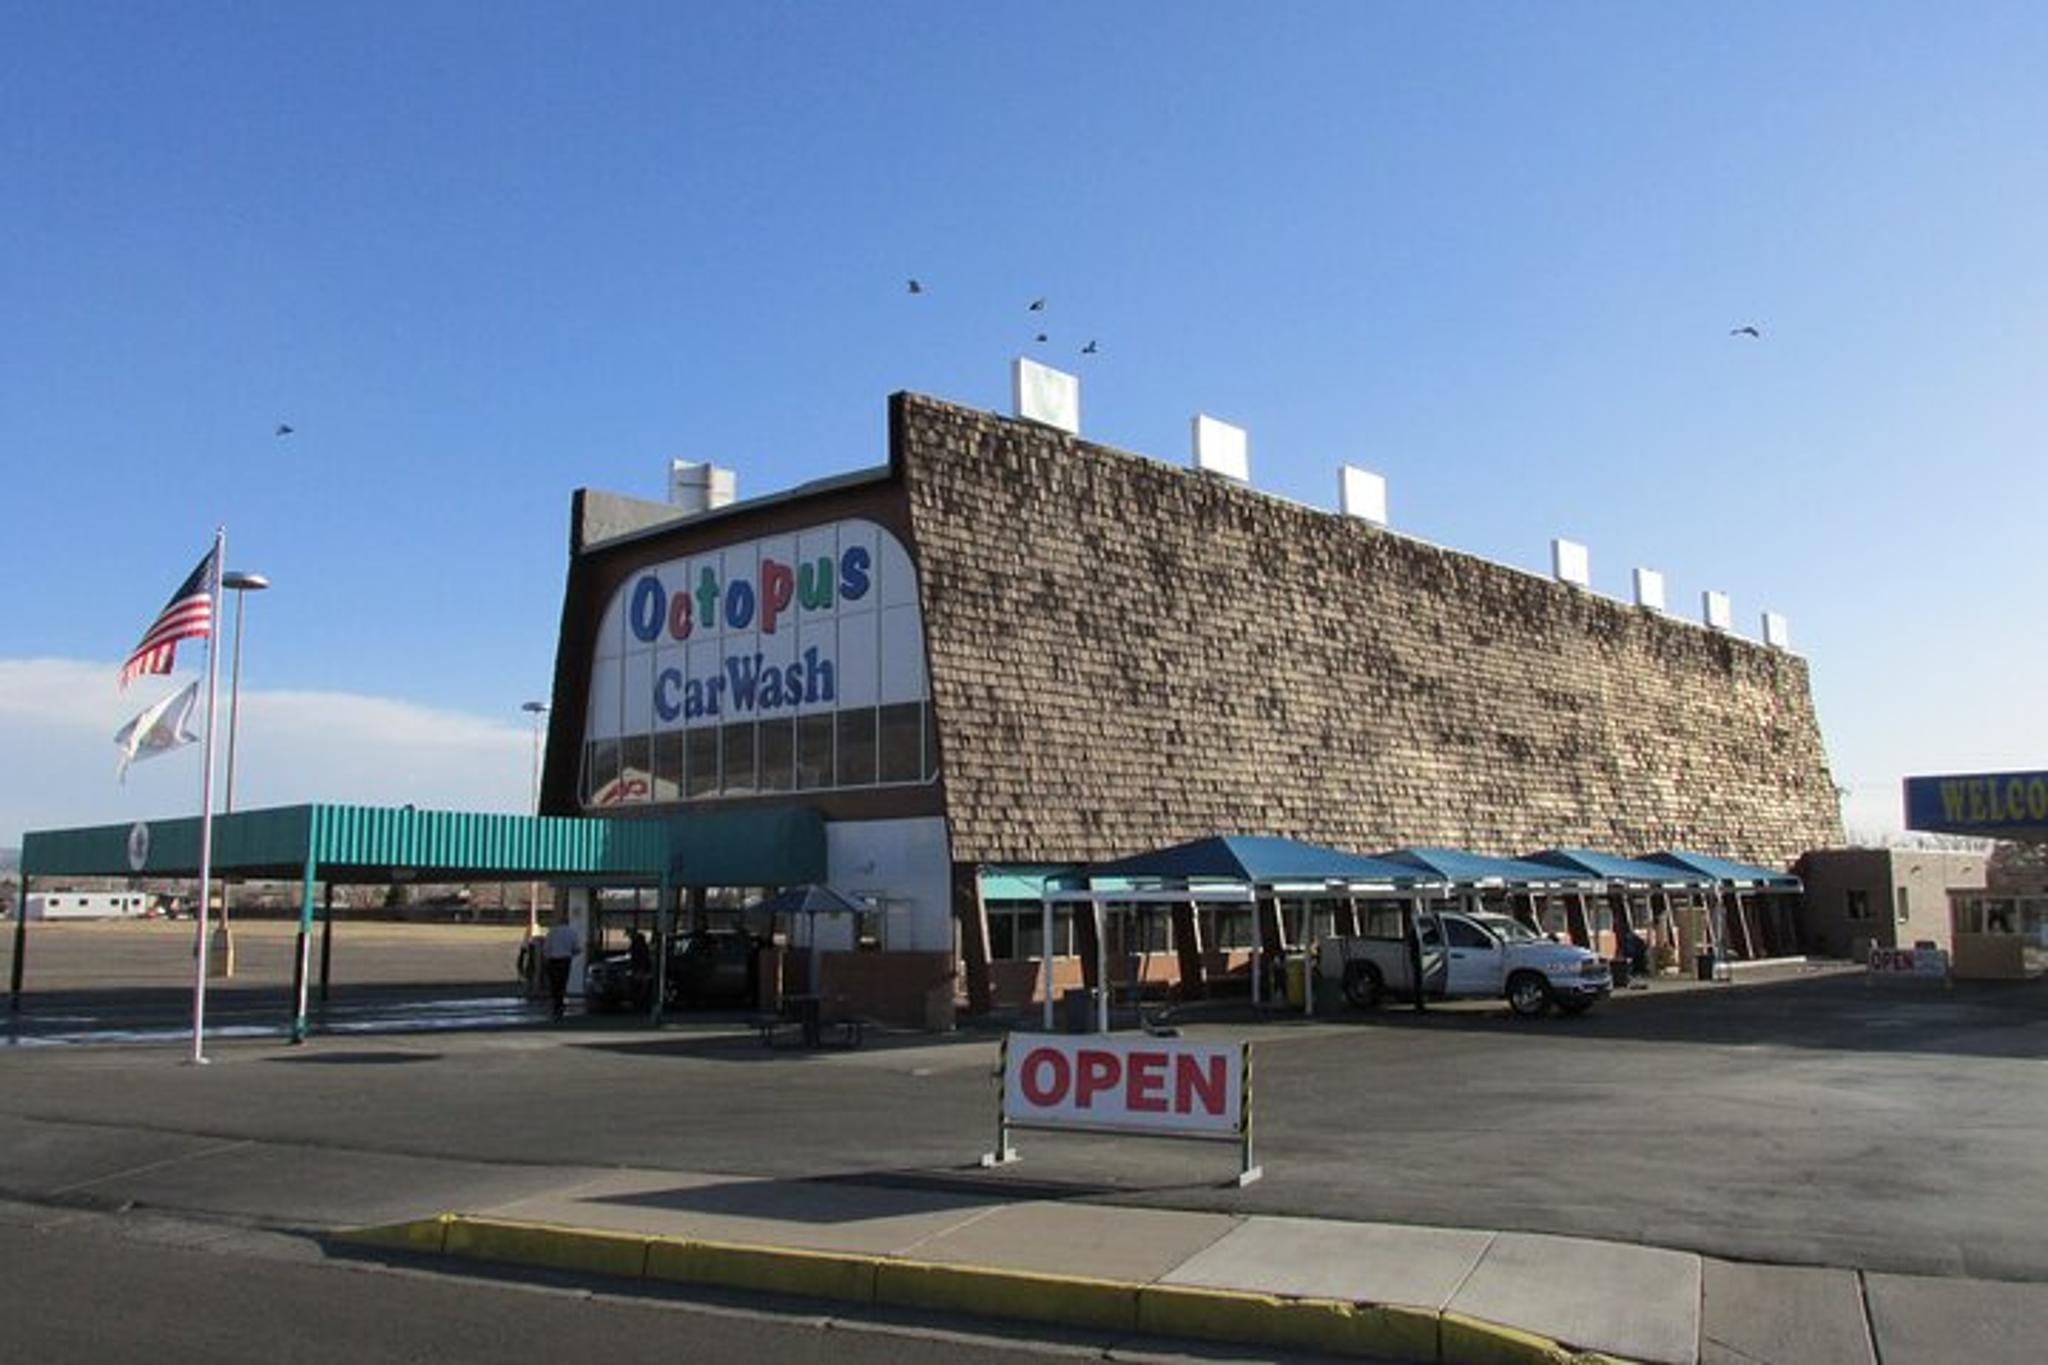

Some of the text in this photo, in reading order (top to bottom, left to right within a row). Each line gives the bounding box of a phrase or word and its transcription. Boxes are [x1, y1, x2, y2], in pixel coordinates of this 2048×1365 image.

[630, 545, 871, 643] Octopus
[1939, 777, 2048, 822] WELCO
[1871, 949, 1914, 971] OPEN
[1020, 1046, 1227, 1116] OPEN
